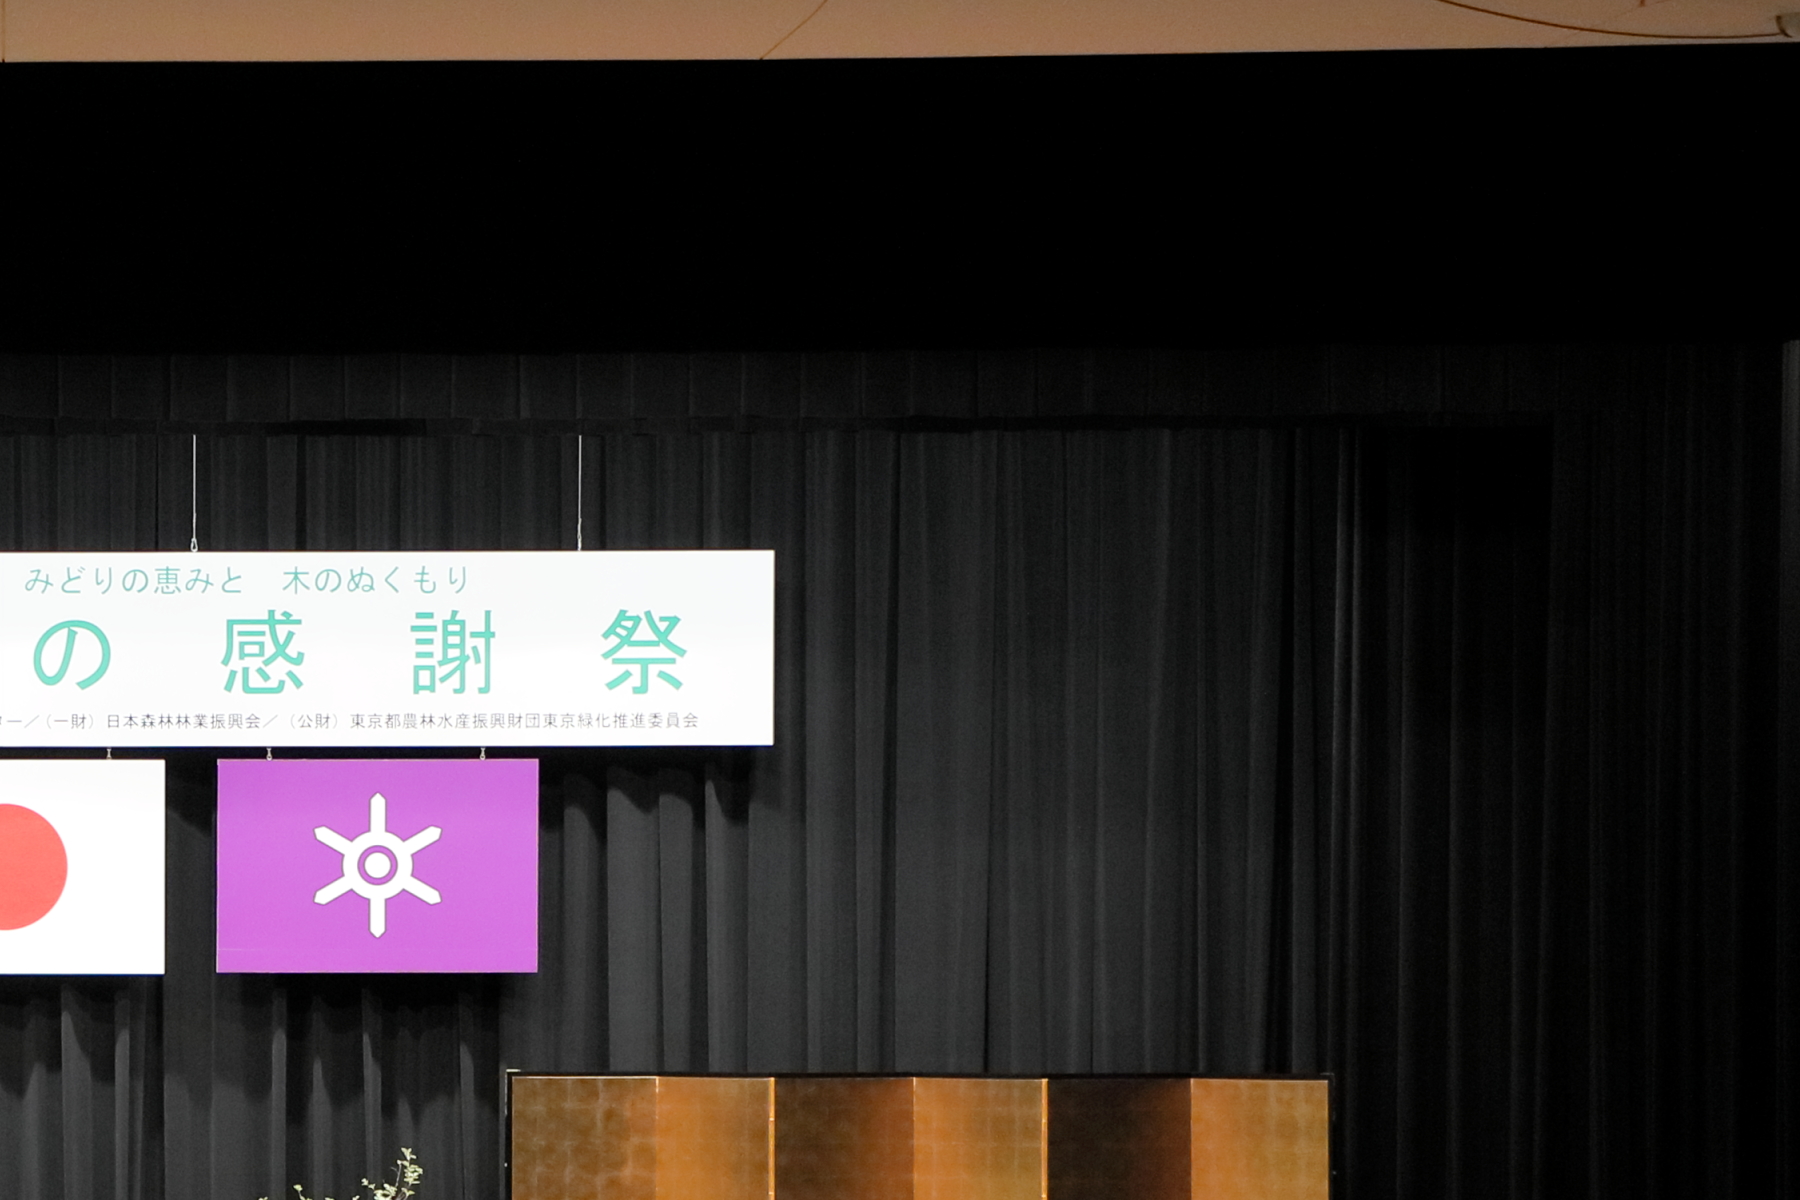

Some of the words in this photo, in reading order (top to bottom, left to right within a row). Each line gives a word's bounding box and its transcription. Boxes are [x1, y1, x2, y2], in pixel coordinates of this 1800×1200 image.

[25, 566, 243, 594] みどりの恵みと
[283, 566, 467, 594] 木のぬくもり
